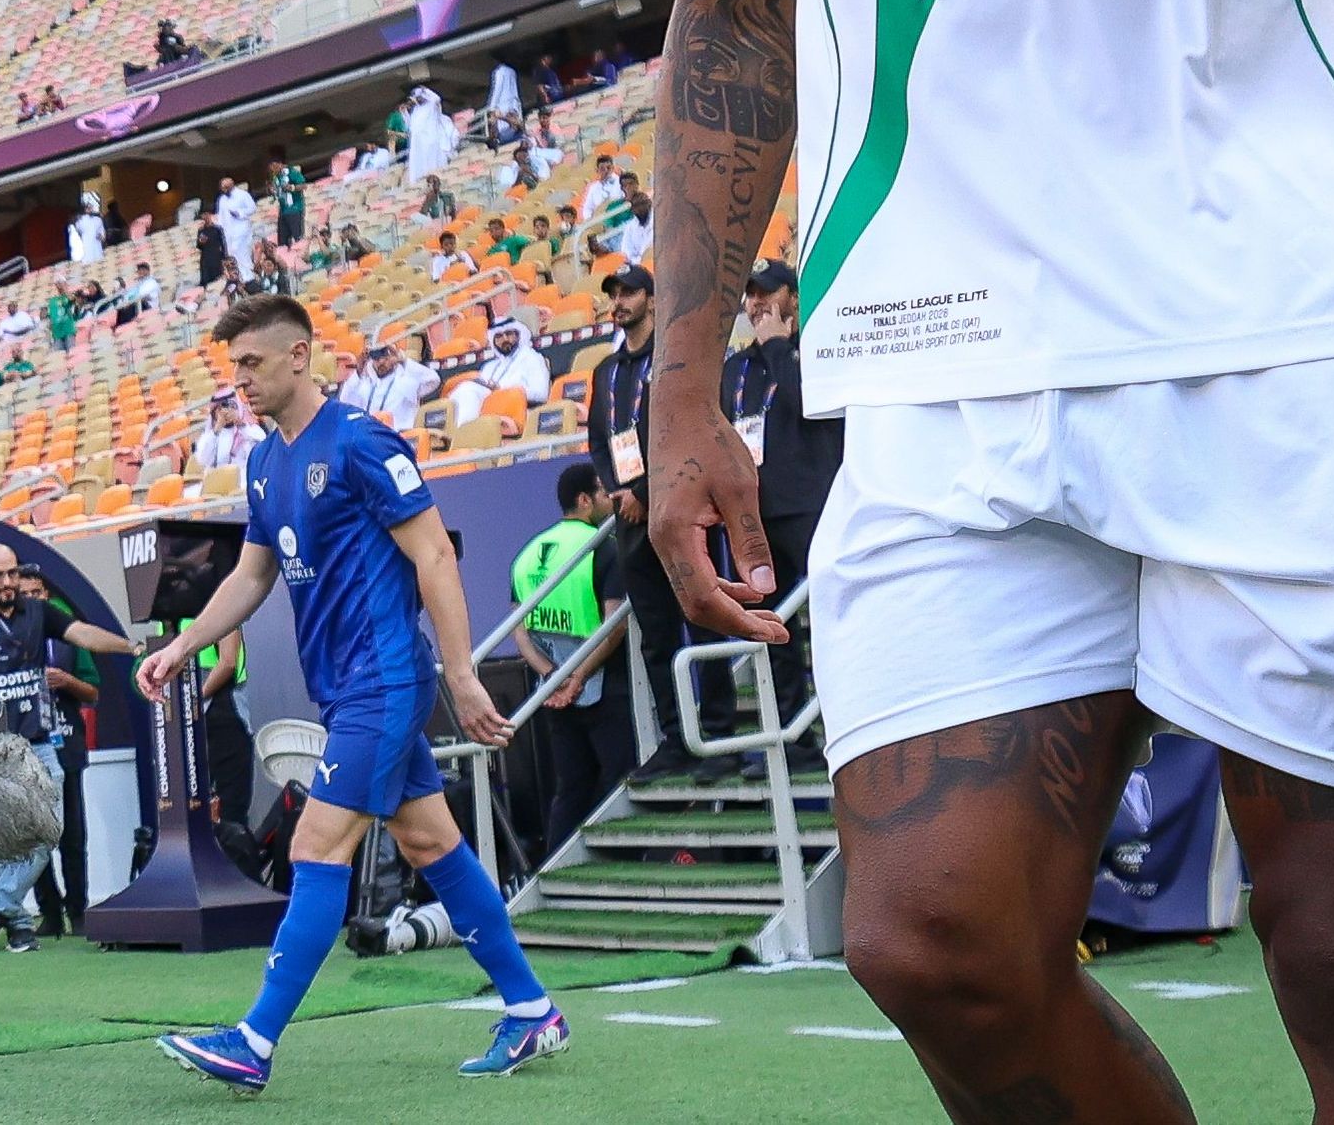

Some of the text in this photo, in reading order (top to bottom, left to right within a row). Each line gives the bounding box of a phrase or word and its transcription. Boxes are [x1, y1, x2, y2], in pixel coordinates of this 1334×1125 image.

[841, 300, 907, 317] CHAMPIONS
[910, 293, 954, 309] LEAGUE
[957, 288, 989, 303] ELITE
[122, 529, 157, 569] VAR
